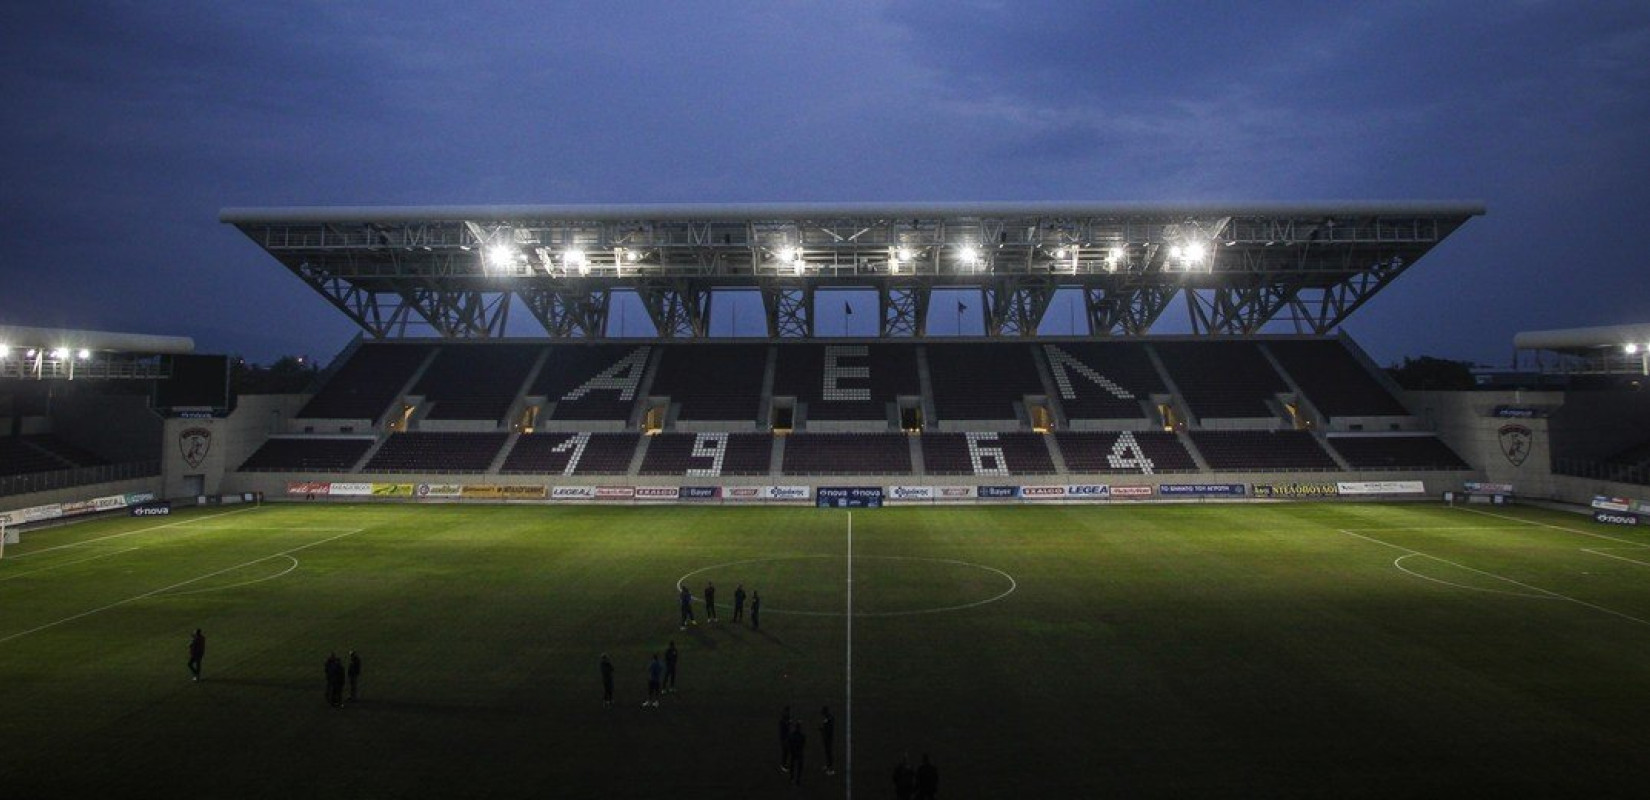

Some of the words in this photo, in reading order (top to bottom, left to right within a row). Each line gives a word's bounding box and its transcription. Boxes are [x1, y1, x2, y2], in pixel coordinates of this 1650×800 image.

[690, 488, 713, 497] Bayer
[1068, 486, 1108, 494] LEGEA
[1608, 516, 1636, 525] nova
